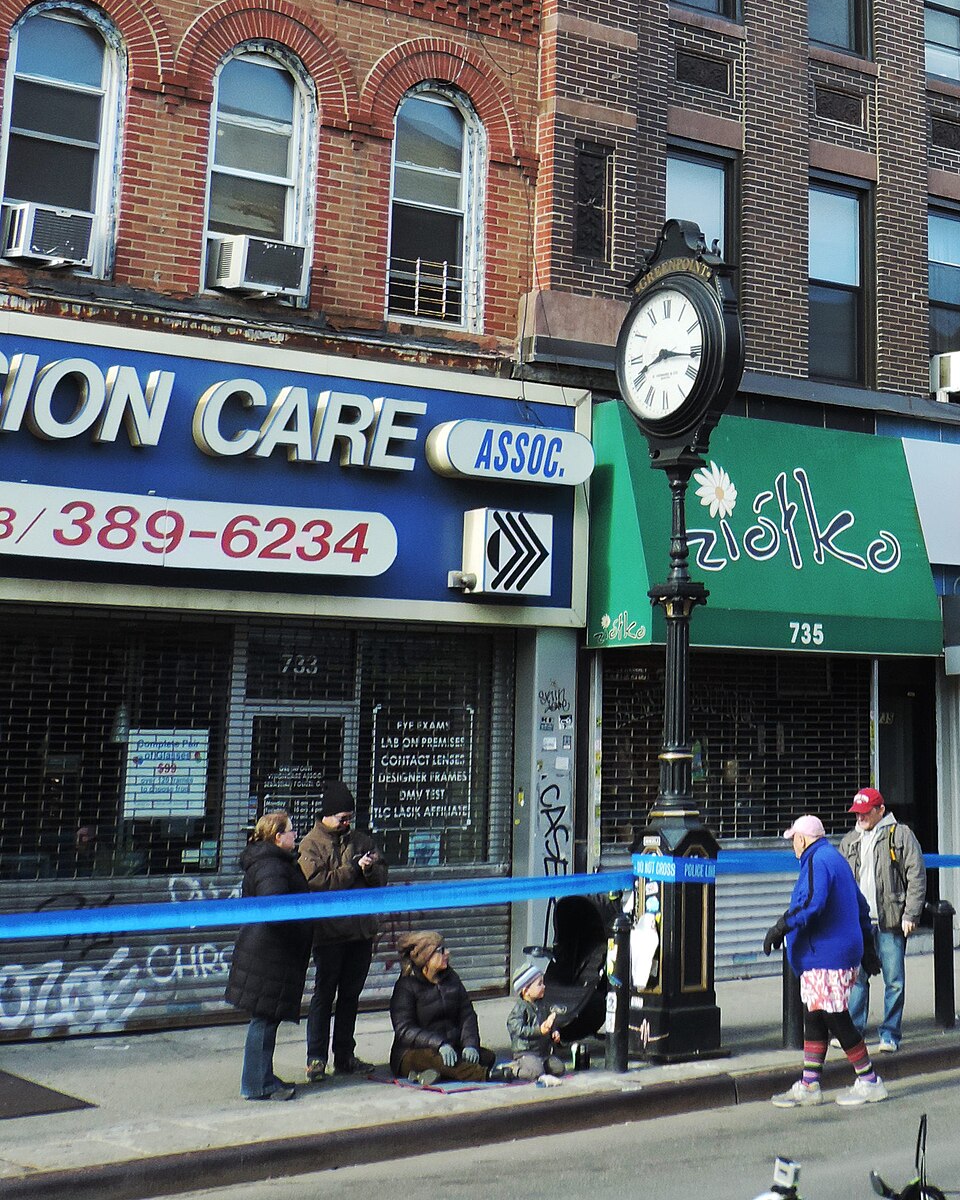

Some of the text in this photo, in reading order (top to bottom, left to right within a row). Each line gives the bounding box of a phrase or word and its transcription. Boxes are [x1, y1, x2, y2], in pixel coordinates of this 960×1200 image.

[0, 352, 428, 472] ION CARE
[474, 428, 565, 479] ASSOC.
[788, 622, 825, 646] 735
[281, 654, 318, 675] 733
[381, 736, 465, 749] LAB ON PREMISES
[380, 753, 465, 767] CONTACT LENSES
[157, 762, 178, 775] $99
[378, 770, 468, 784] DESIGNER FRAMES
[399, 788, 446, 801] DMV TEST
[373, 804, 468, 819] TLC LASIK AFFILIATE
[636, 860, 716, 879] DO NOT CROSS POLICE LIN
